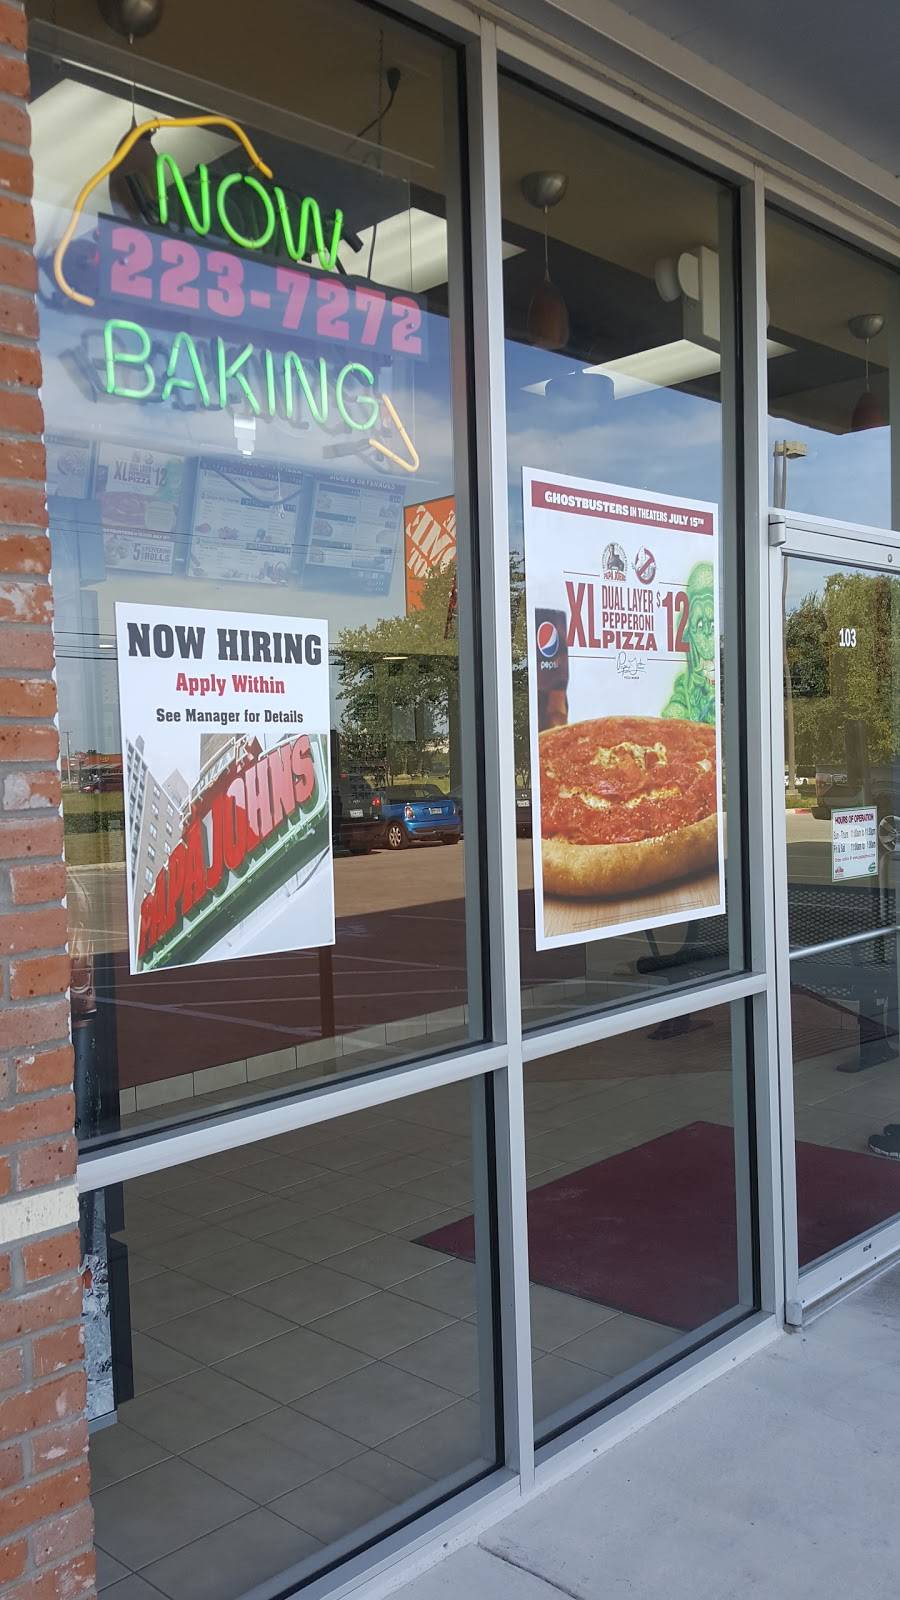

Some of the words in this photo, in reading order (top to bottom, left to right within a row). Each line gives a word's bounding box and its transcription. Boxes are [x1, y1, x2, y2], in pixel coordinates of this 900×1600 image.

[157, 153, 343, 270] NOW
[110, 227, 422, 355] 223-7272
[104, 319, 379, 430] BAKING
[544, 490, 629, 516] GHOSTBUSTERS
[629, 507, 637, 518] IN
[638, 508, 667, 523] THEATERS
[668, 513, 689, 526] JULY
[601, 585, 625, 612] DUAL
[627, 587, 654, 613] LAYER
[565, 581, 603, 649] XL
[602, 611, 654, 631] PEPPERONI
[127, 622, 206, 660] NOW
[216, 626, 322, 666] HIRING
[602, 630, 658, 652] PIZZA
[839, 628, 857, 648] 103
[540, 660, 560, 671] pepsi
[176, 672, 227, 697] Apply
[231, 675, 286, 694] Within
[156, 708, 183, 722] See
[185, 709, 240, 726] Manager
[244, 709, 260, 723] for
[264, 709, 304, 724] Details
[835, 816, 848, 825] HOURS
[848, 815, 854, 824] OF
[854, 813, 874, 823] OPERATION
[138, 803, 208, 960] PAPA
